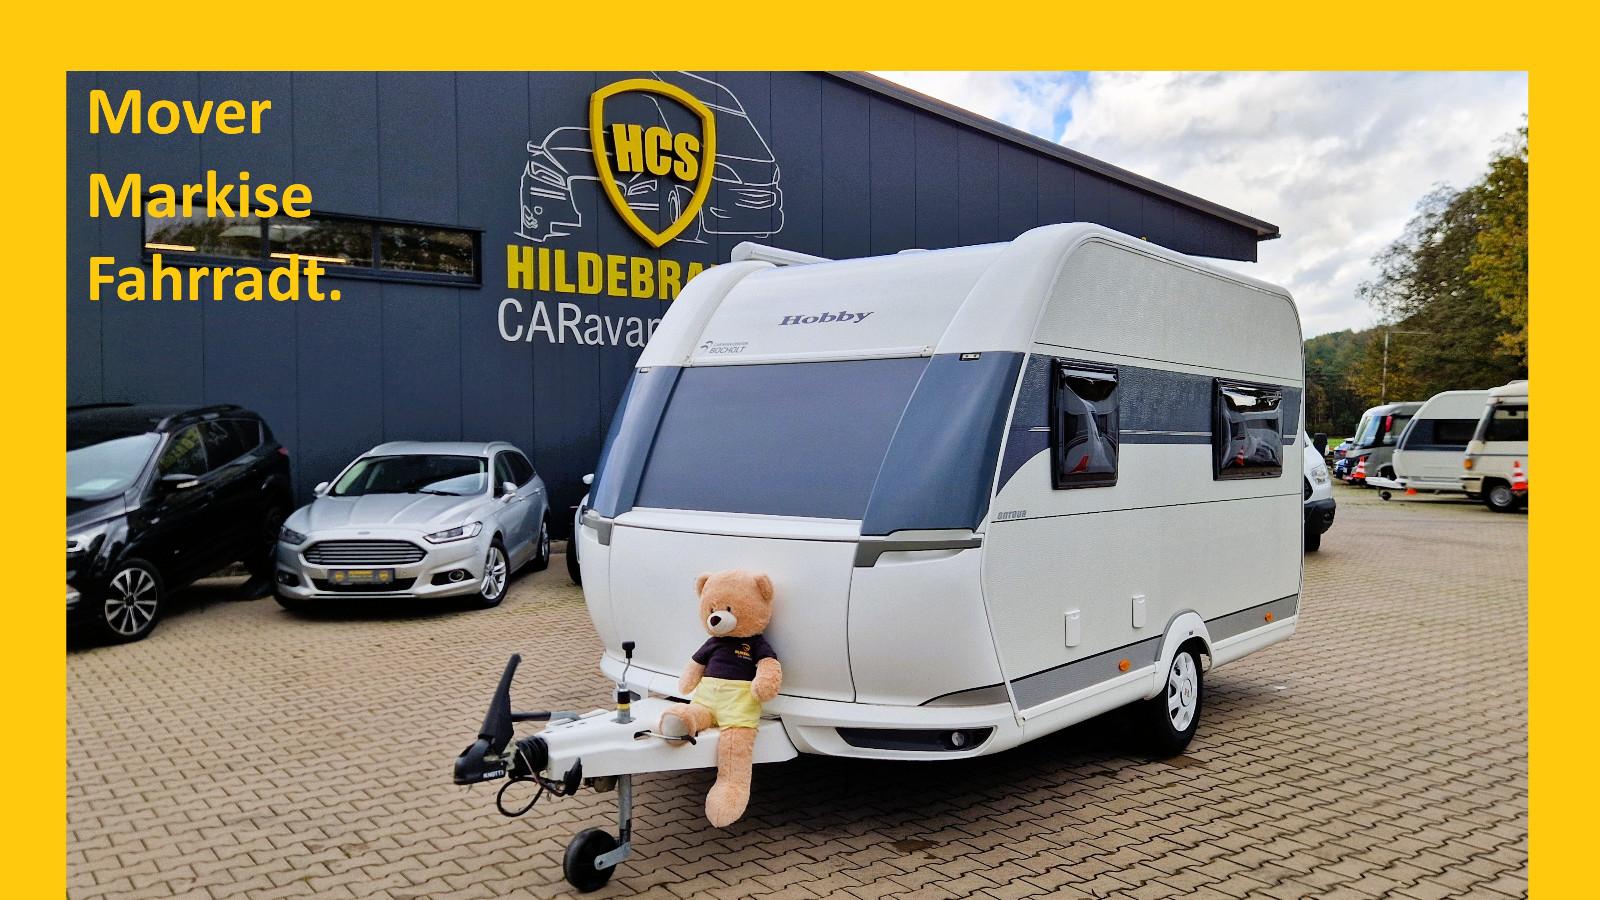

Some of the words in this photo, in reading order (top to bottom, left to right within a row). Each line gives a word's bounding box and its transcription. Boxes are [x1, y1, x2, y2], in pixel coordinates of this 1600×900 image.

[612, 123, 700, 182] HCS
[507, 244, 722, 300] HILDEBRA
[778, 310, 875, 326] Hobby
